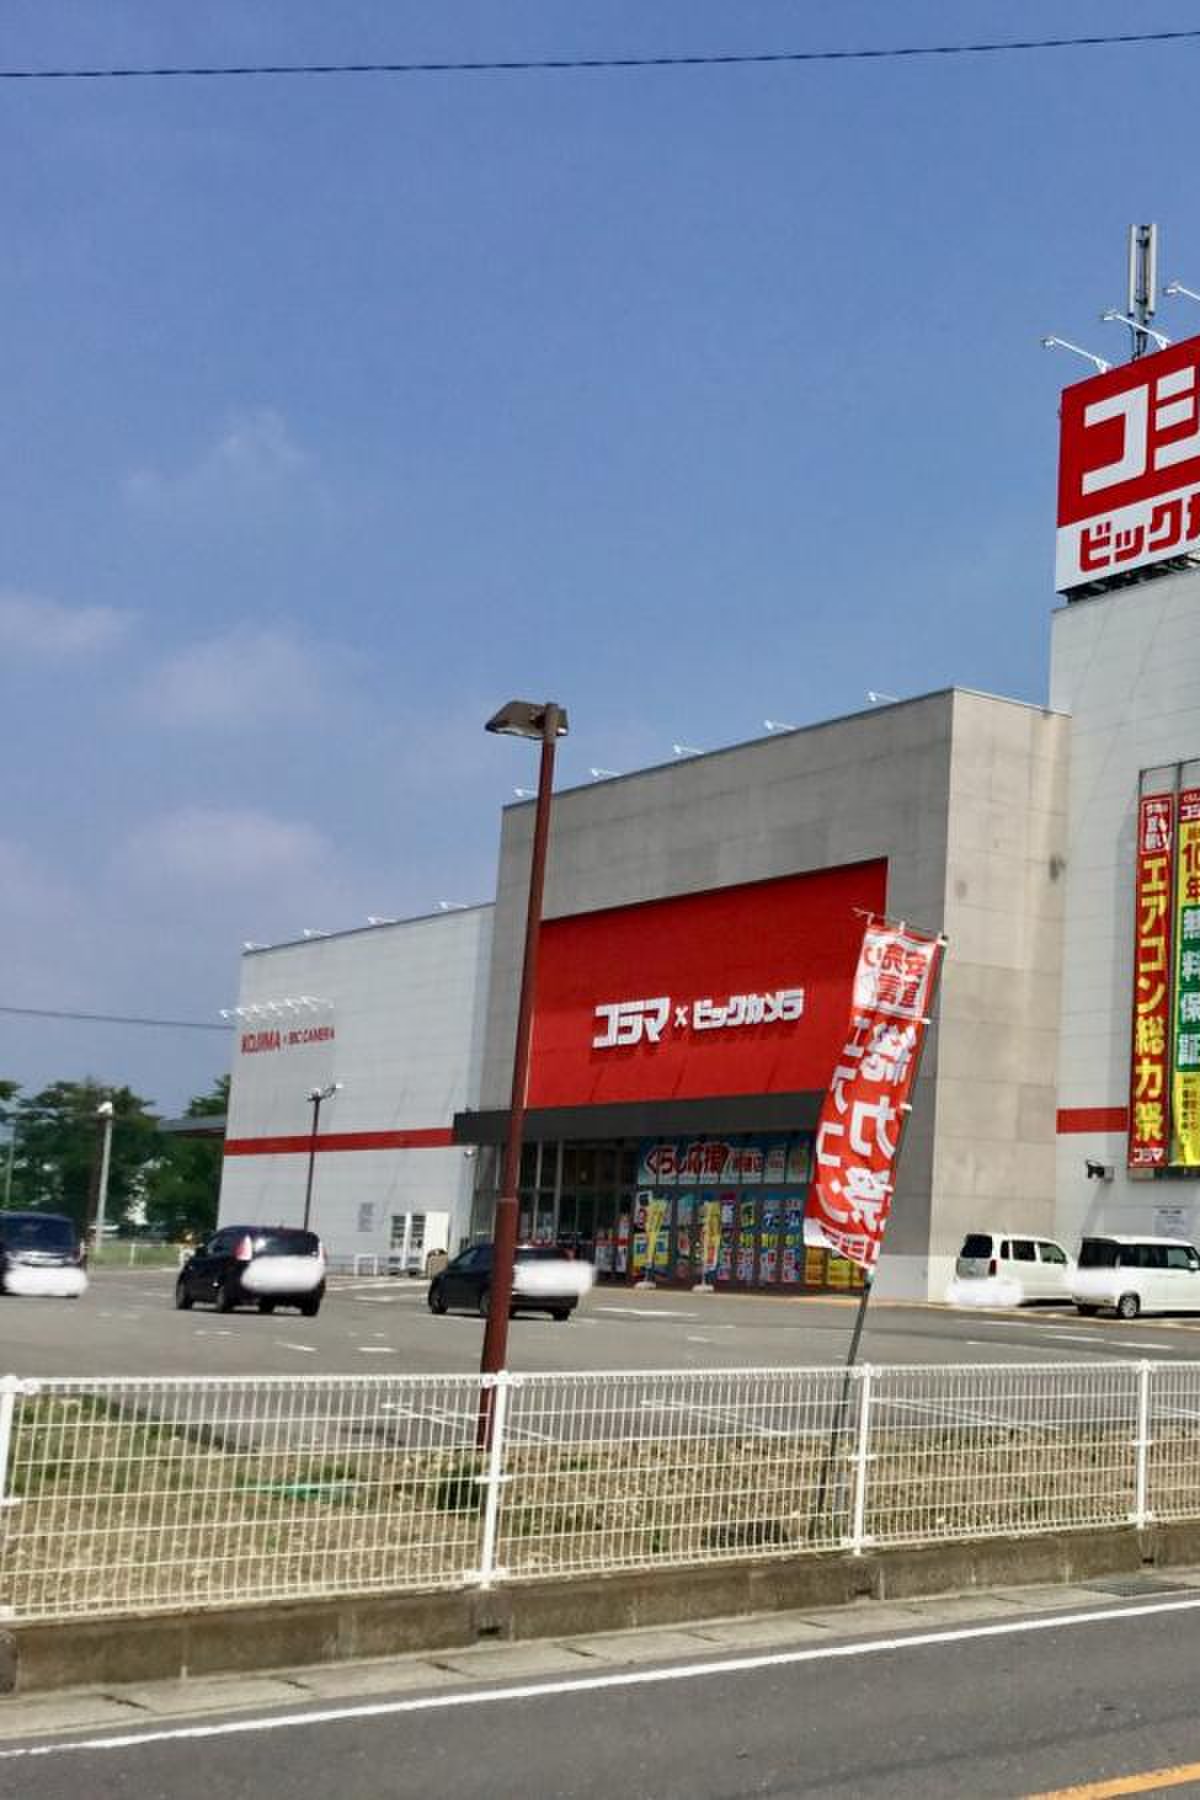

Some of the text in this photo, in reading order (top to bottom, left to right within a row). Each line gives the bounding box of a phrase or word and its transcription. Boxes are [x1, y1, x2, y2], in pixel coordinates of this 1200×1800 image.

[592, 997, 671, 1048] コジマ
[693, 988, 804, 1030] ビックカメラ
[241, 1030, 280, 1053] KOJIMA
